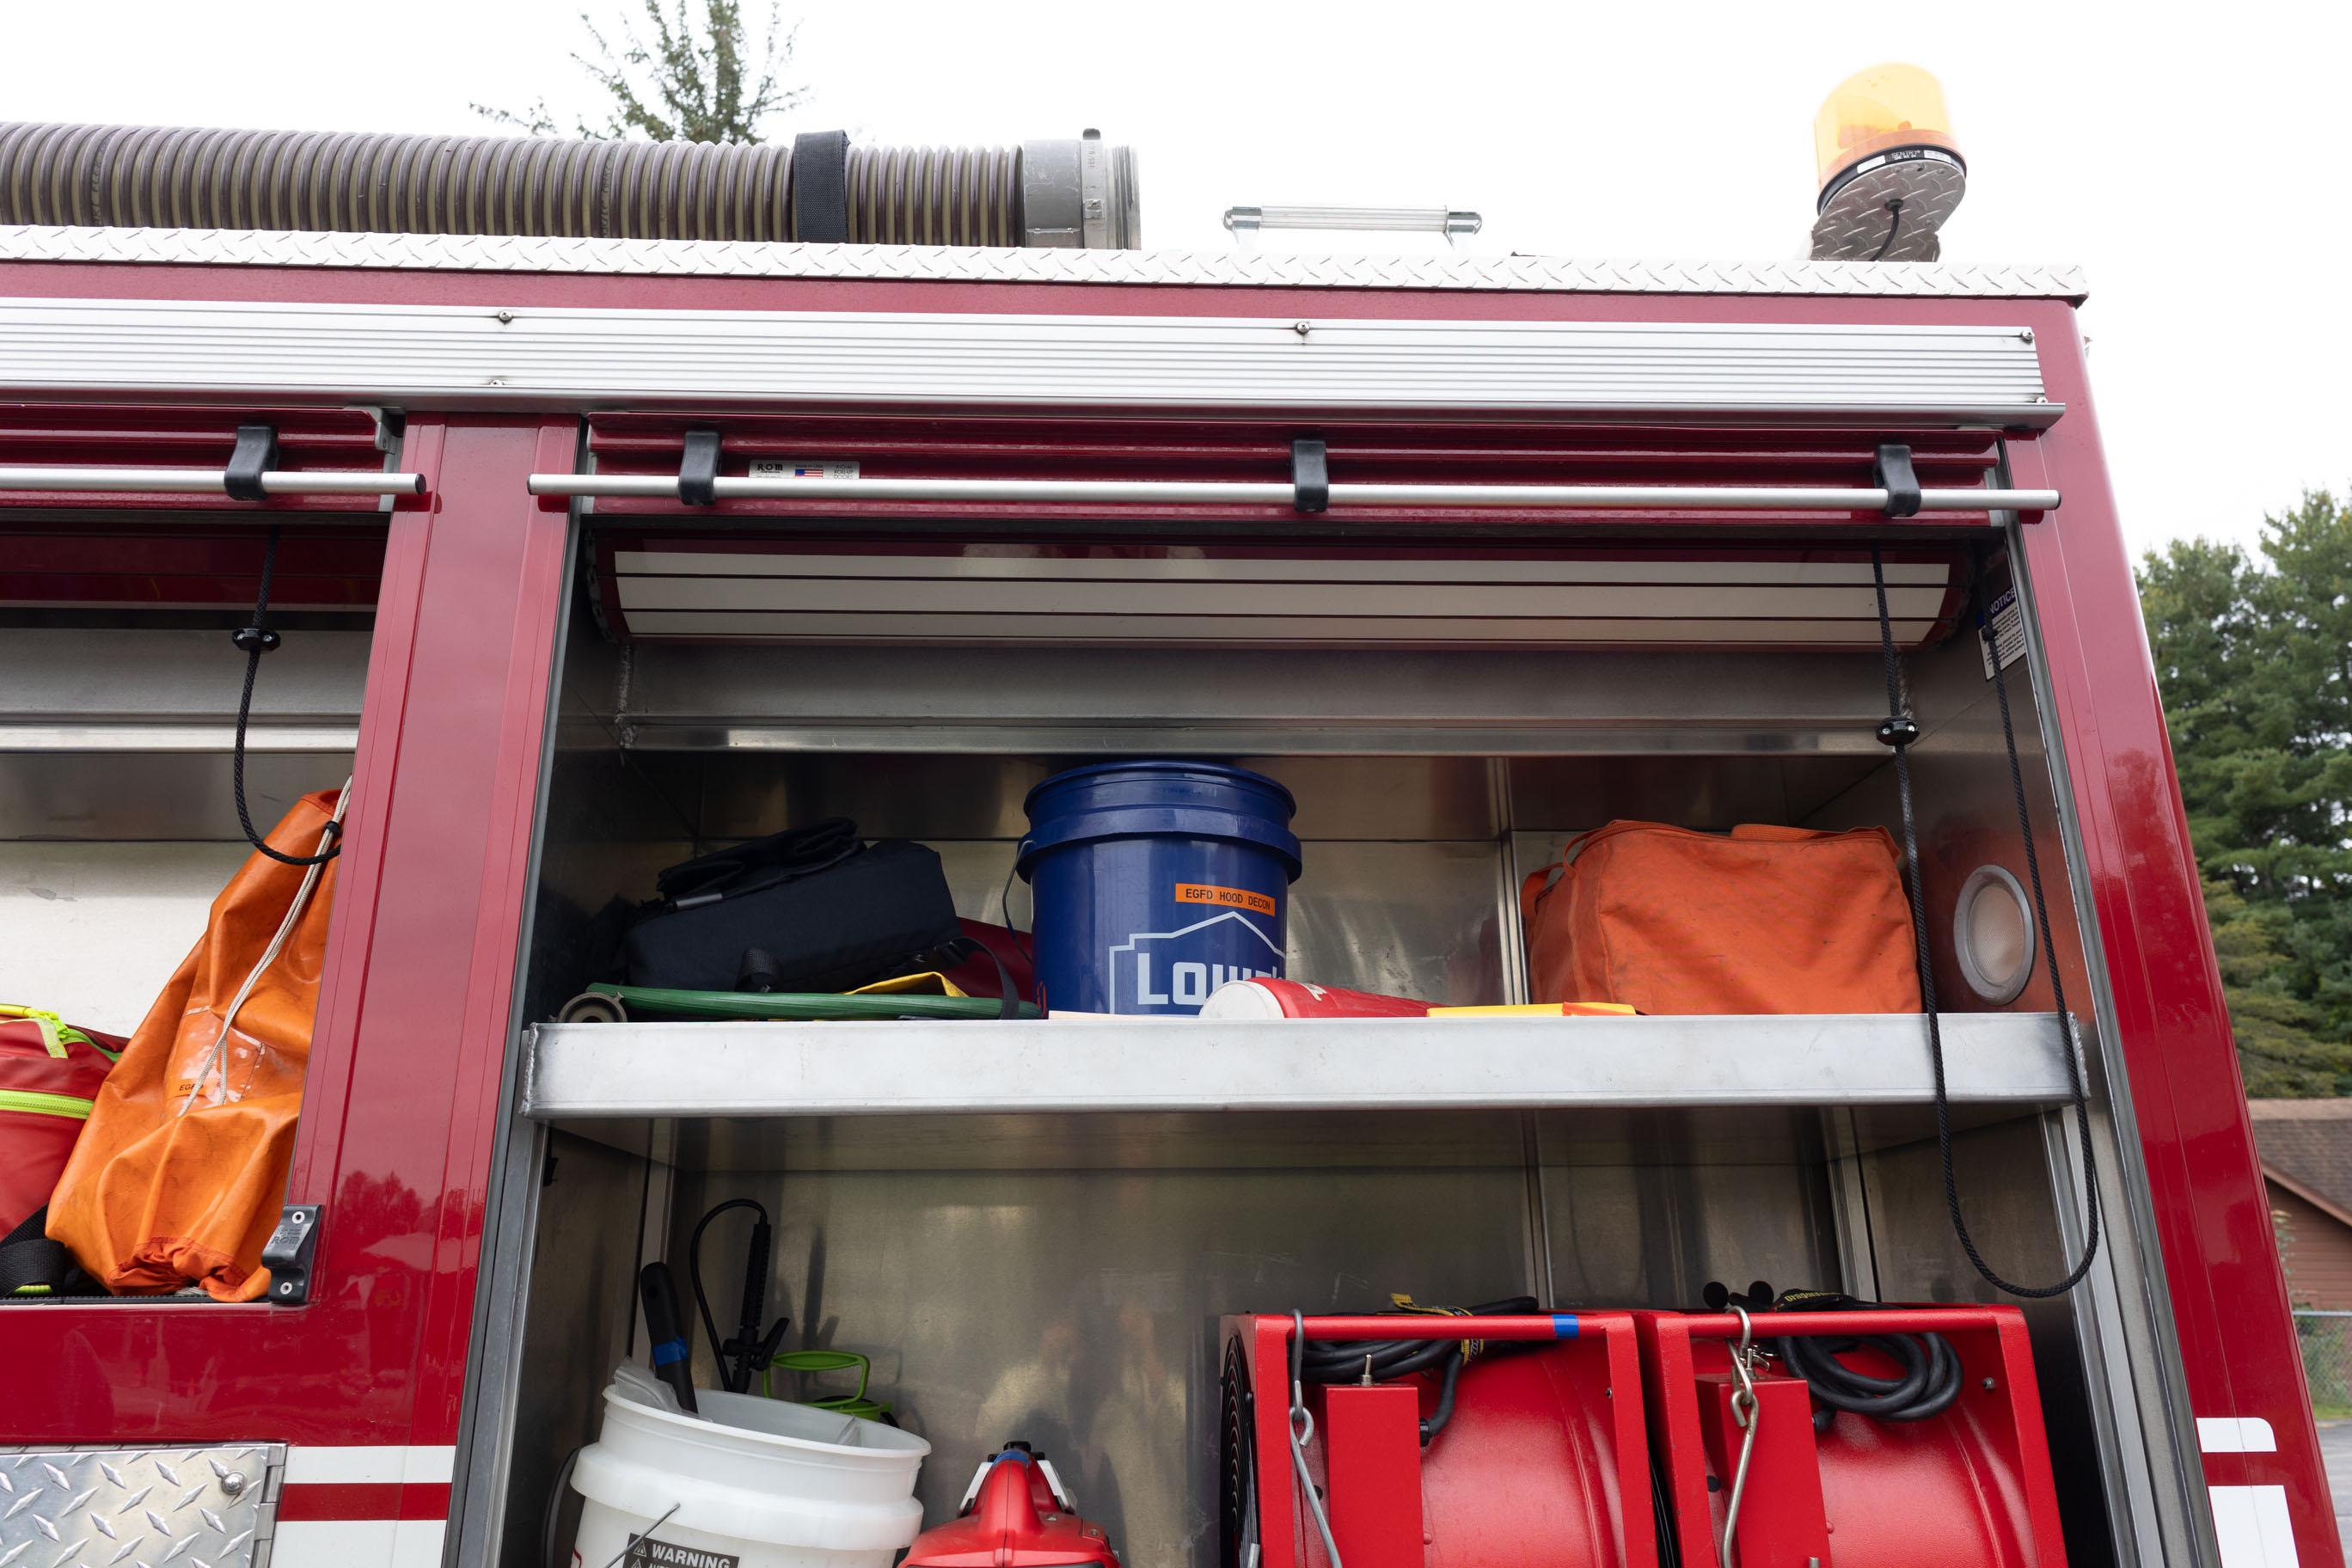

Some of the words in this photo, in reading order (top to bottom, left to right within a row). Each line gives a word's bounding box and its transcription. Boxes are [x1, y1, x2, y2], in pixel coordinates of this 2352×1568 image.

[1185, 888, 1213, 899] EGFD
[1219, 891, 1243, 903] HOOD
[1248, 896, 1271, 910] DECON
[652, 1543, 731, 1568] WARNING
